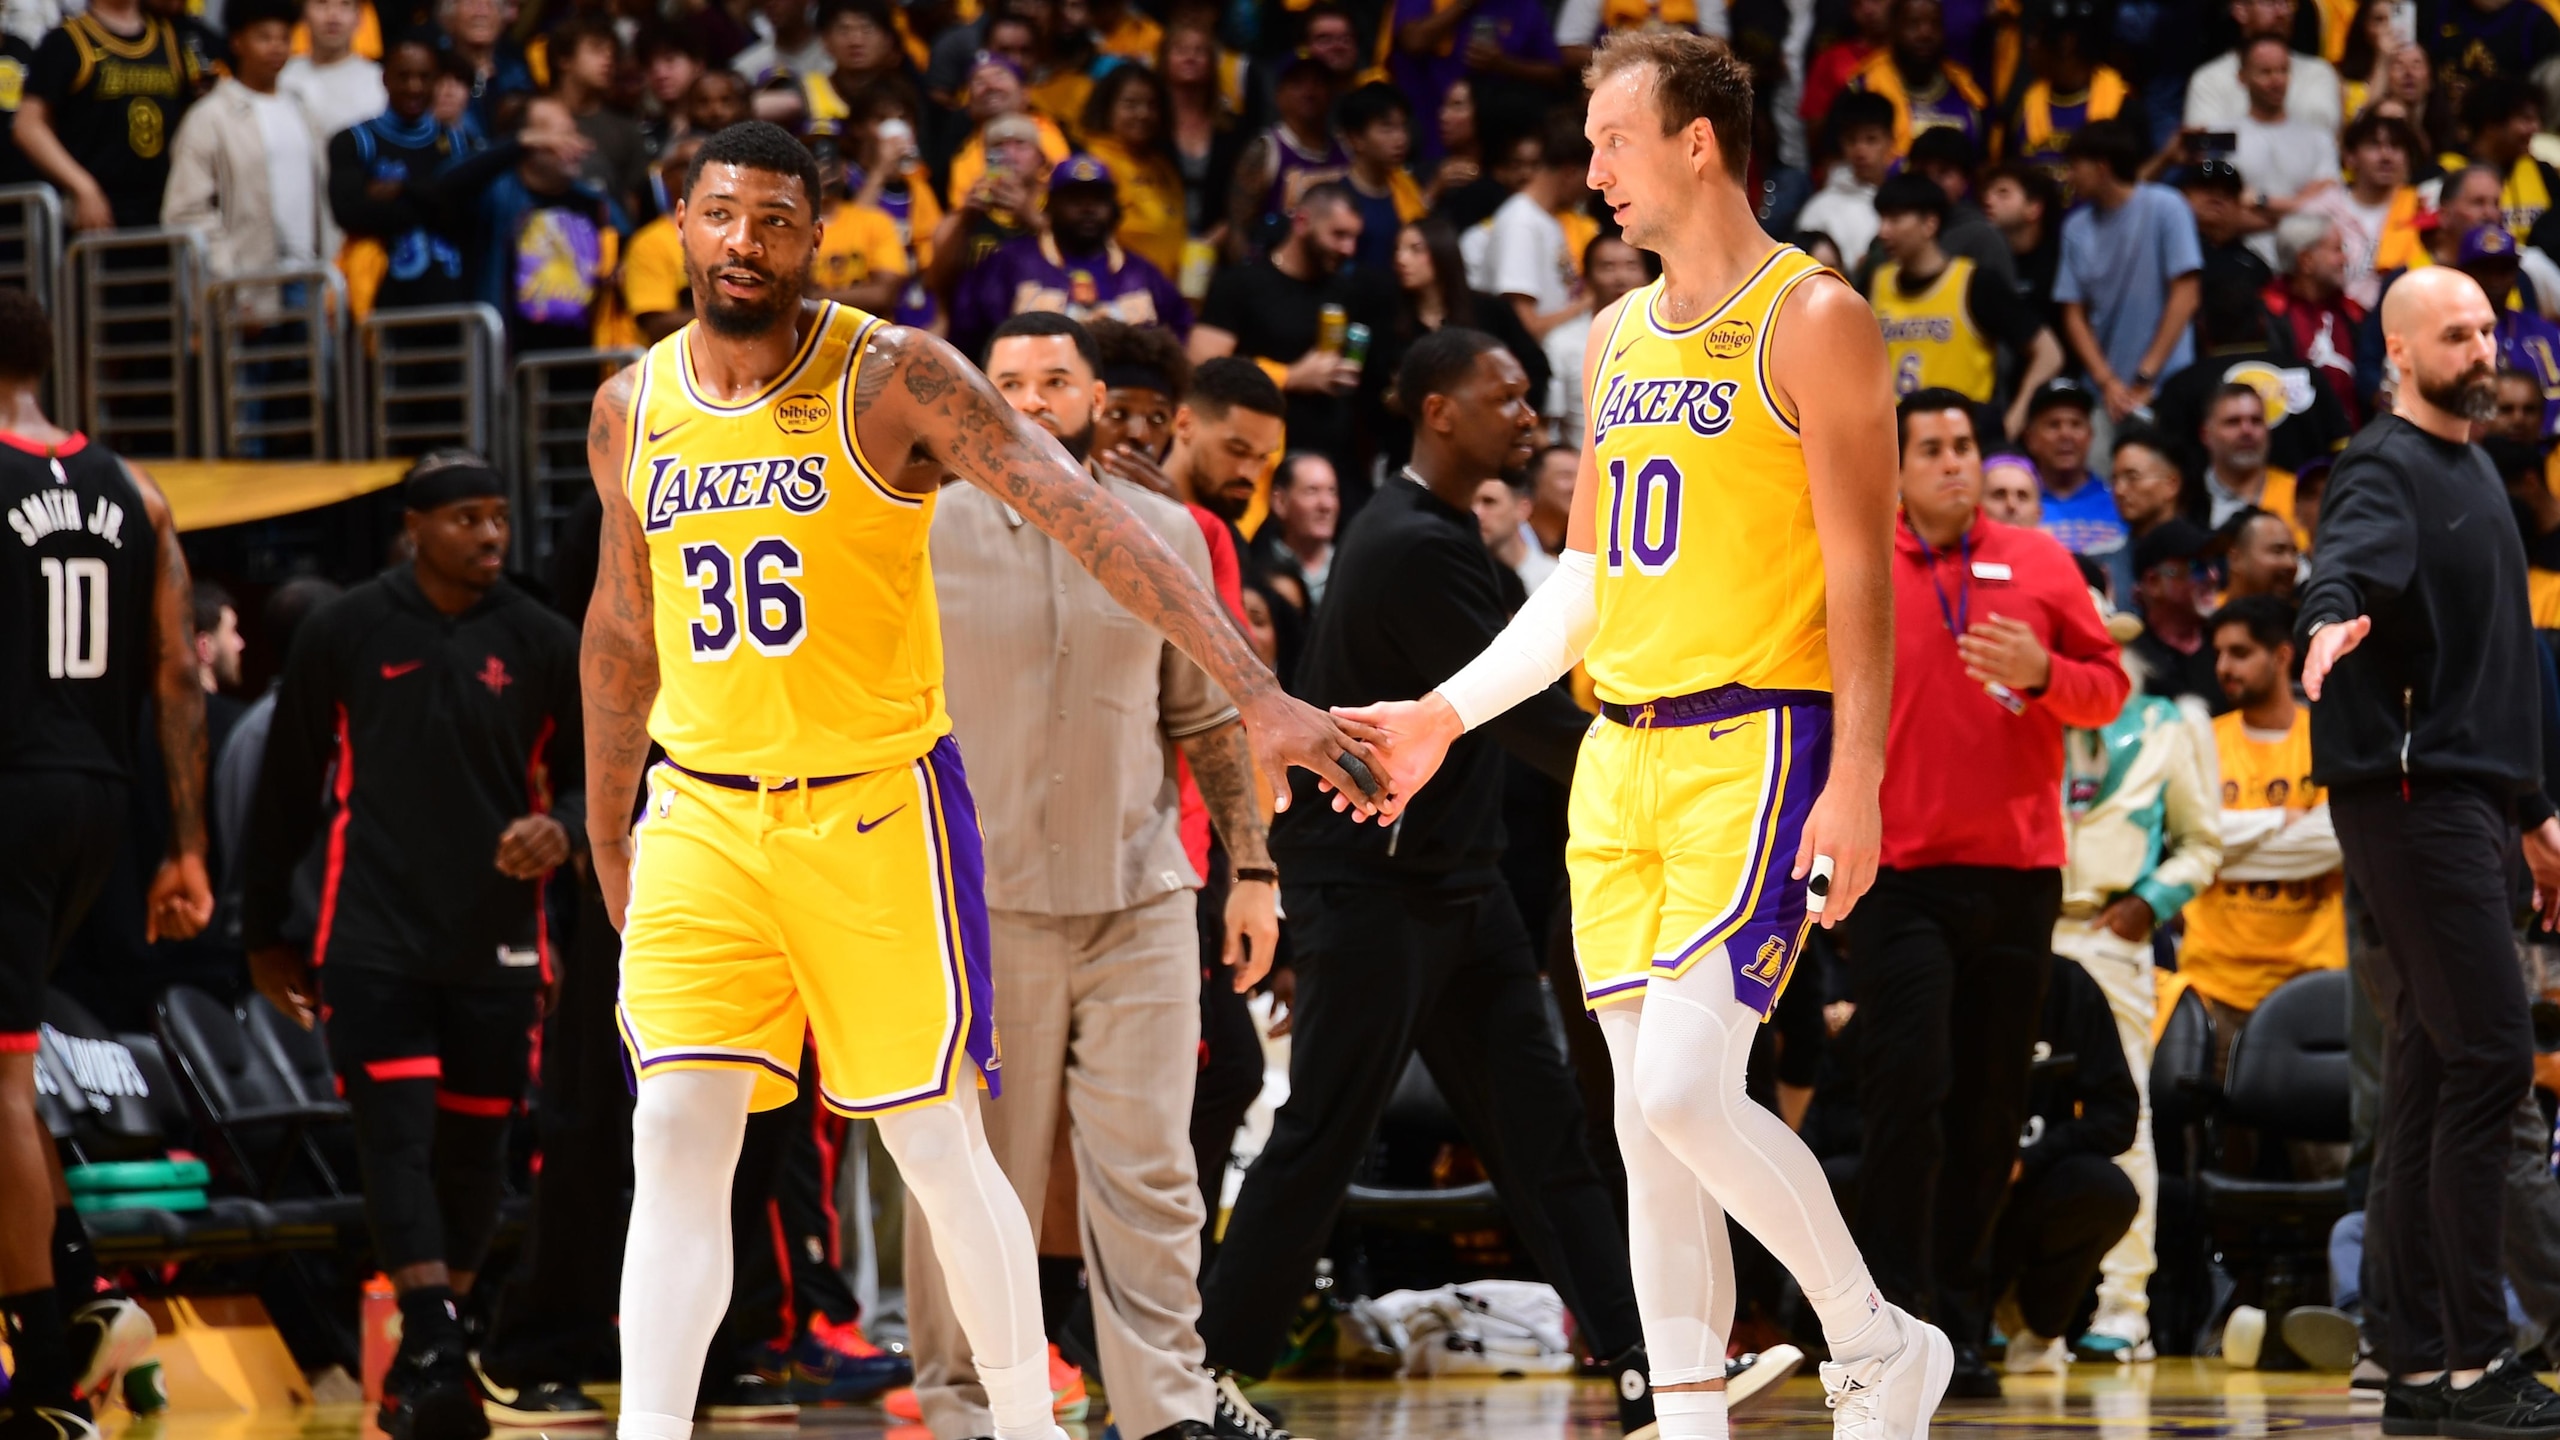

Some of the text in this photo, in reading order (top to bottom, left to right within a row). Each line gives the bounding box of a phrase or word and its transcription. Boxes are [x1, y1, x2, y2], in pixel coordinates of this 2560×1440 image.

[128, 97, 163, 158] 8
[1710, 330, 1751, 348] bibigo
[1880, 315, 1953, 342] AKERS
[780, 404, 827, 422] bibigo
[1594, 373, 1740, 444] LAKERS
[8, 489, 82, 547] SMITH
[645, 454, 830, 535] LAKERS
[1608, 457, 1682, 577] 10
[41, 557, 109, 679] 10
[680, 536, 808, 662] 36
